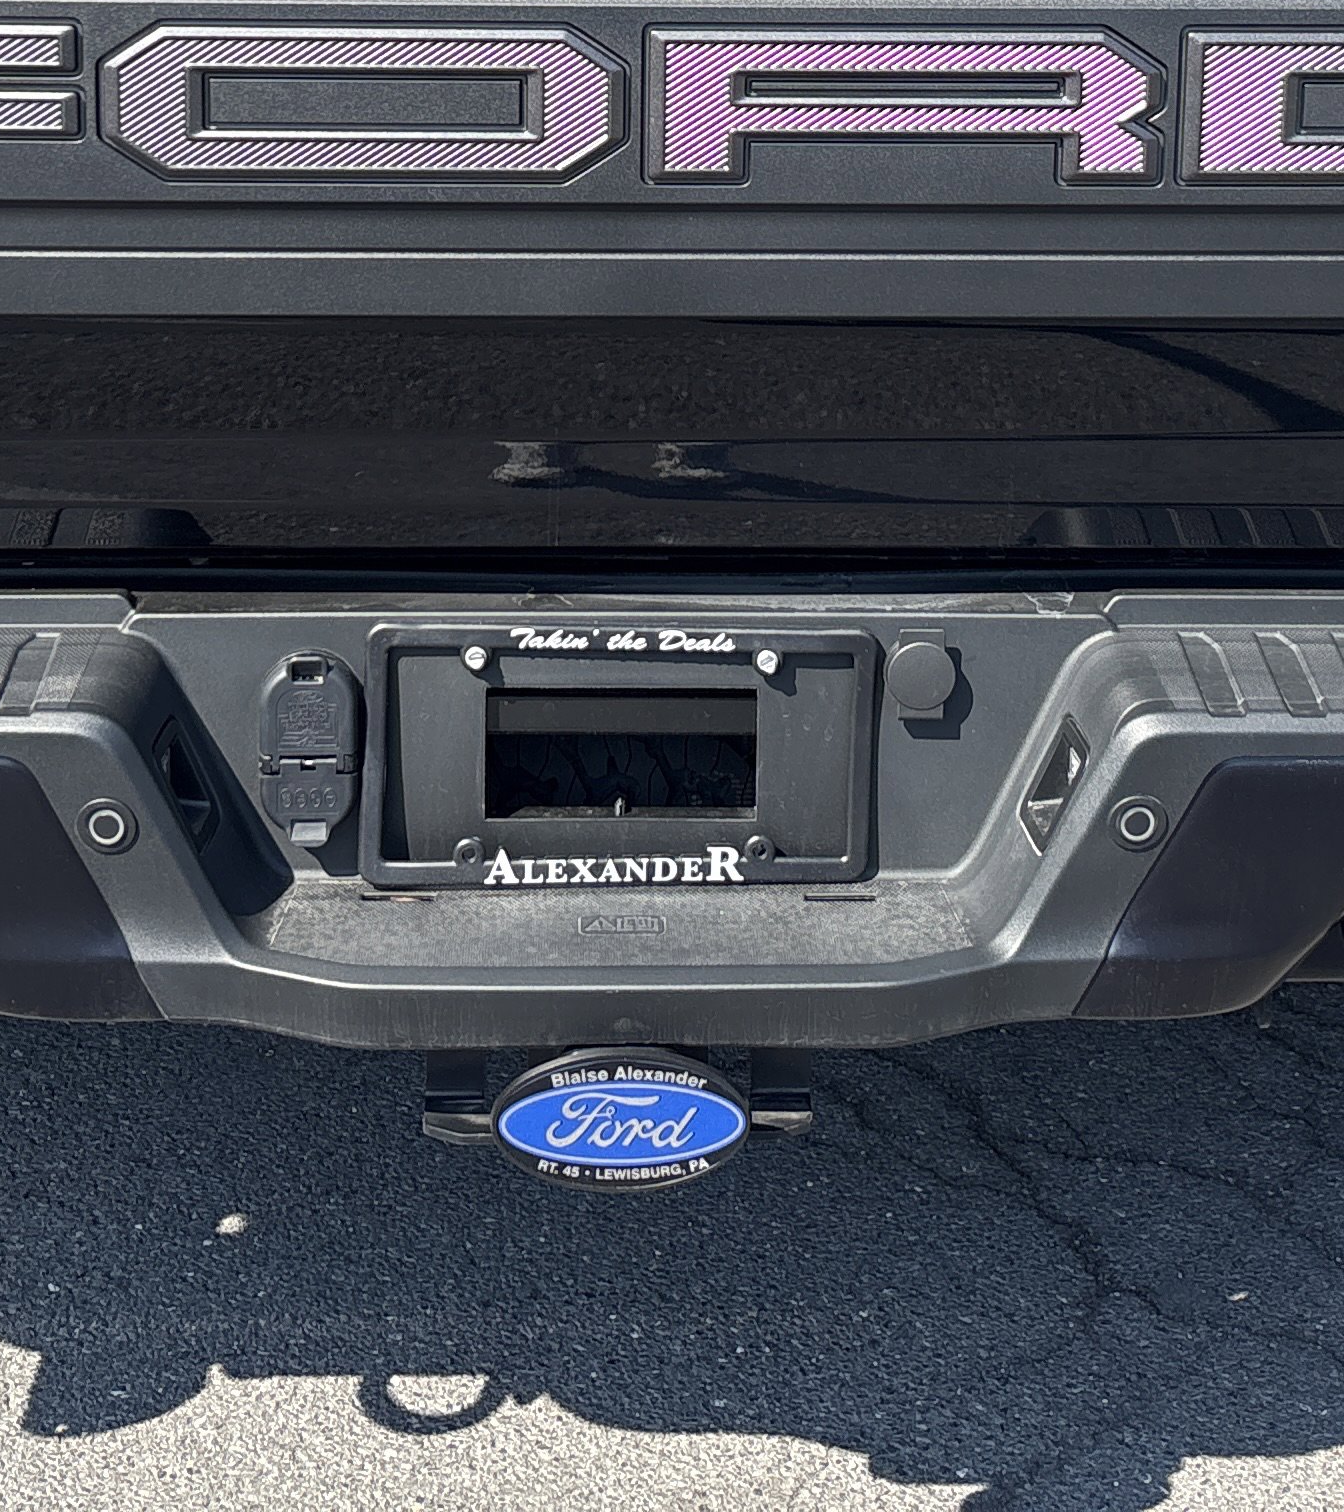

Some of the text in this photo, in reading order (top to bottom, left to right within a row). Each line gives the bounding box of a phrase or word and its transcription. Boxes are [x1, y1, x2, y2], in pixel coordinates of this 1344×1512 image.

[510, 627, 736, 652] Takin' the Deals
[483, 847, 745, 885] ALEXANDER
[551, 1065, 708, 1089] Blaise Alexander
[546, 1092, 699, 1148] Ford
[537, 1157, 710, 1180] RT. 45 LEWISBURG, PA
